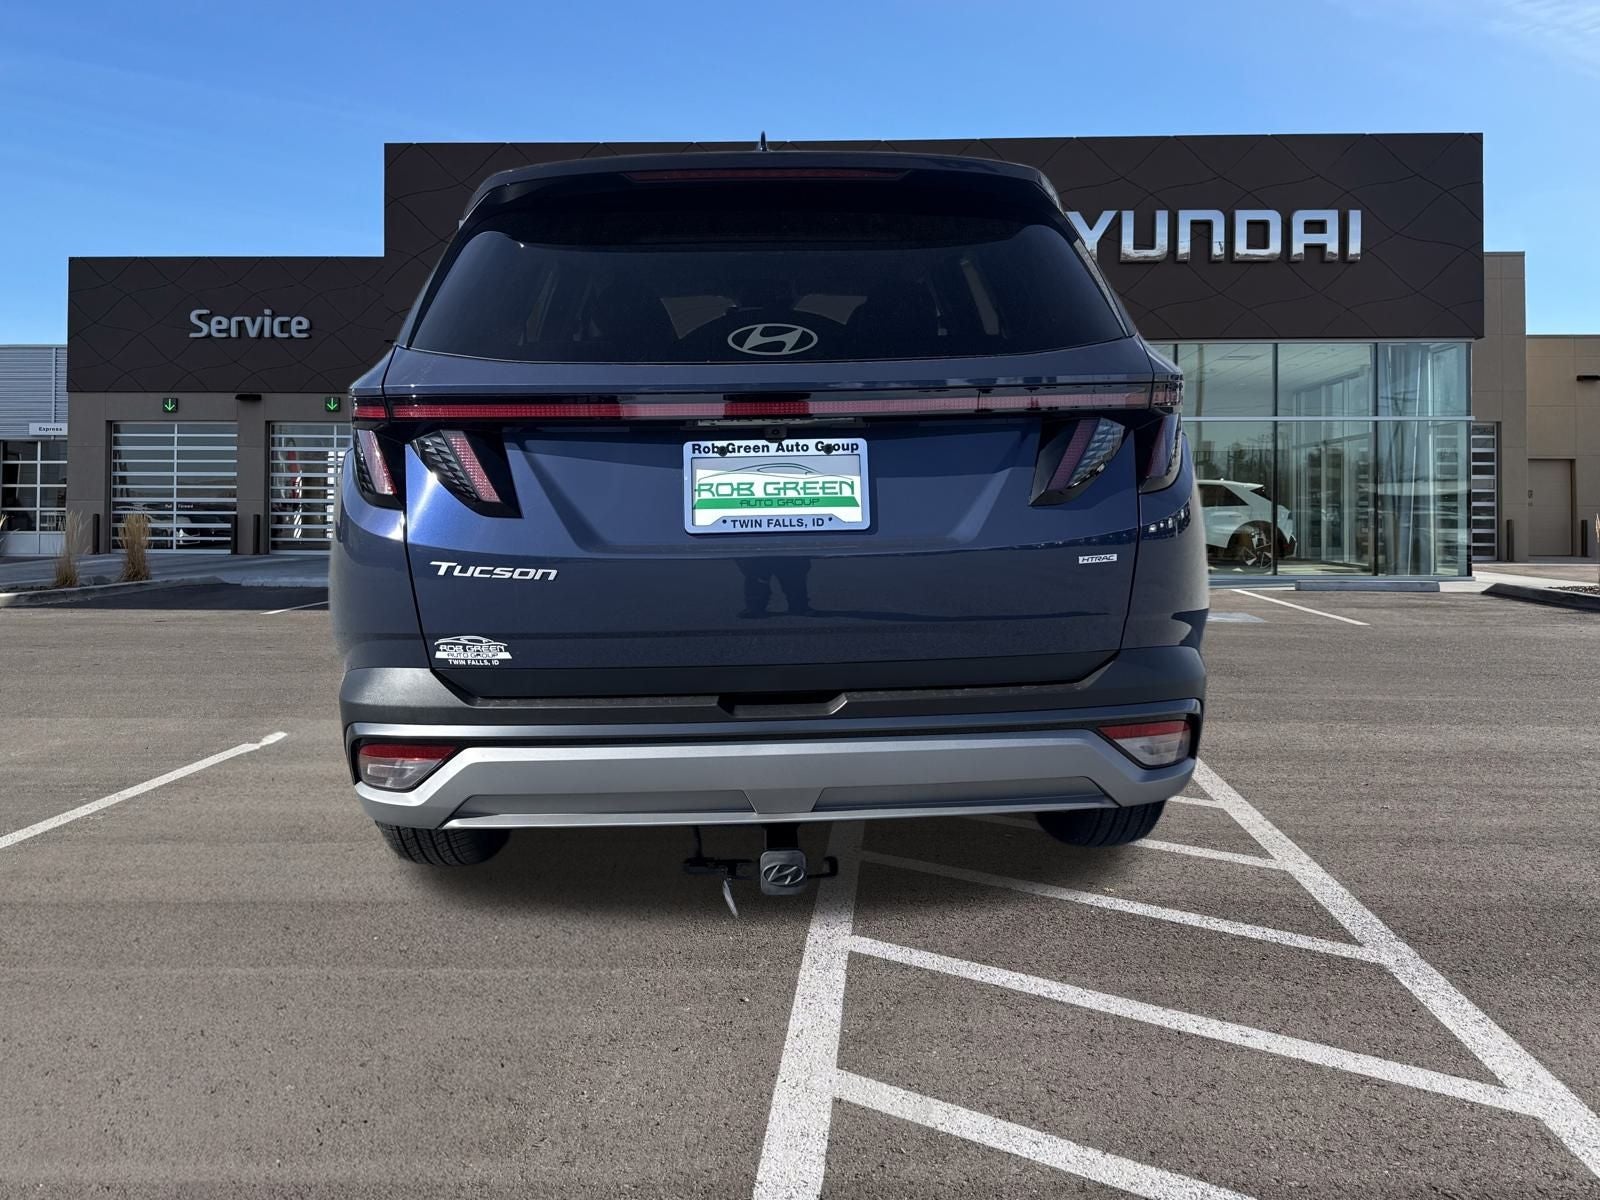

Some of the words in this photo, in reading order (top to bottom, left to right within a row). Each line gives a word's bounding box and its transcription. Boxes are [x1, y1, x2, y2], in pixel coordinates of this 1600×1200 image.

[1066, 209, 1362, 263] YUNDAI
[189, 308, 311, 339] Service
[691, 443, 720, 455] Rob
[726, 442, 770, 454] Green
[775, 441, 810, 453] Auto
[815, 440, 860, 453] Goup
[694, 481, 755, 498] ROB
[763, 480, 855, 497] GREEN
[739, 499, 774, 508] AUTO
[777, 498, 820, 507] GROUP
[730, 518, 763, 529] TWIN
[767, 518, 808, 529] FALLS,
[812, 518, 825, 528] ID
[1081, 555, 1115, 563] HTRAC
